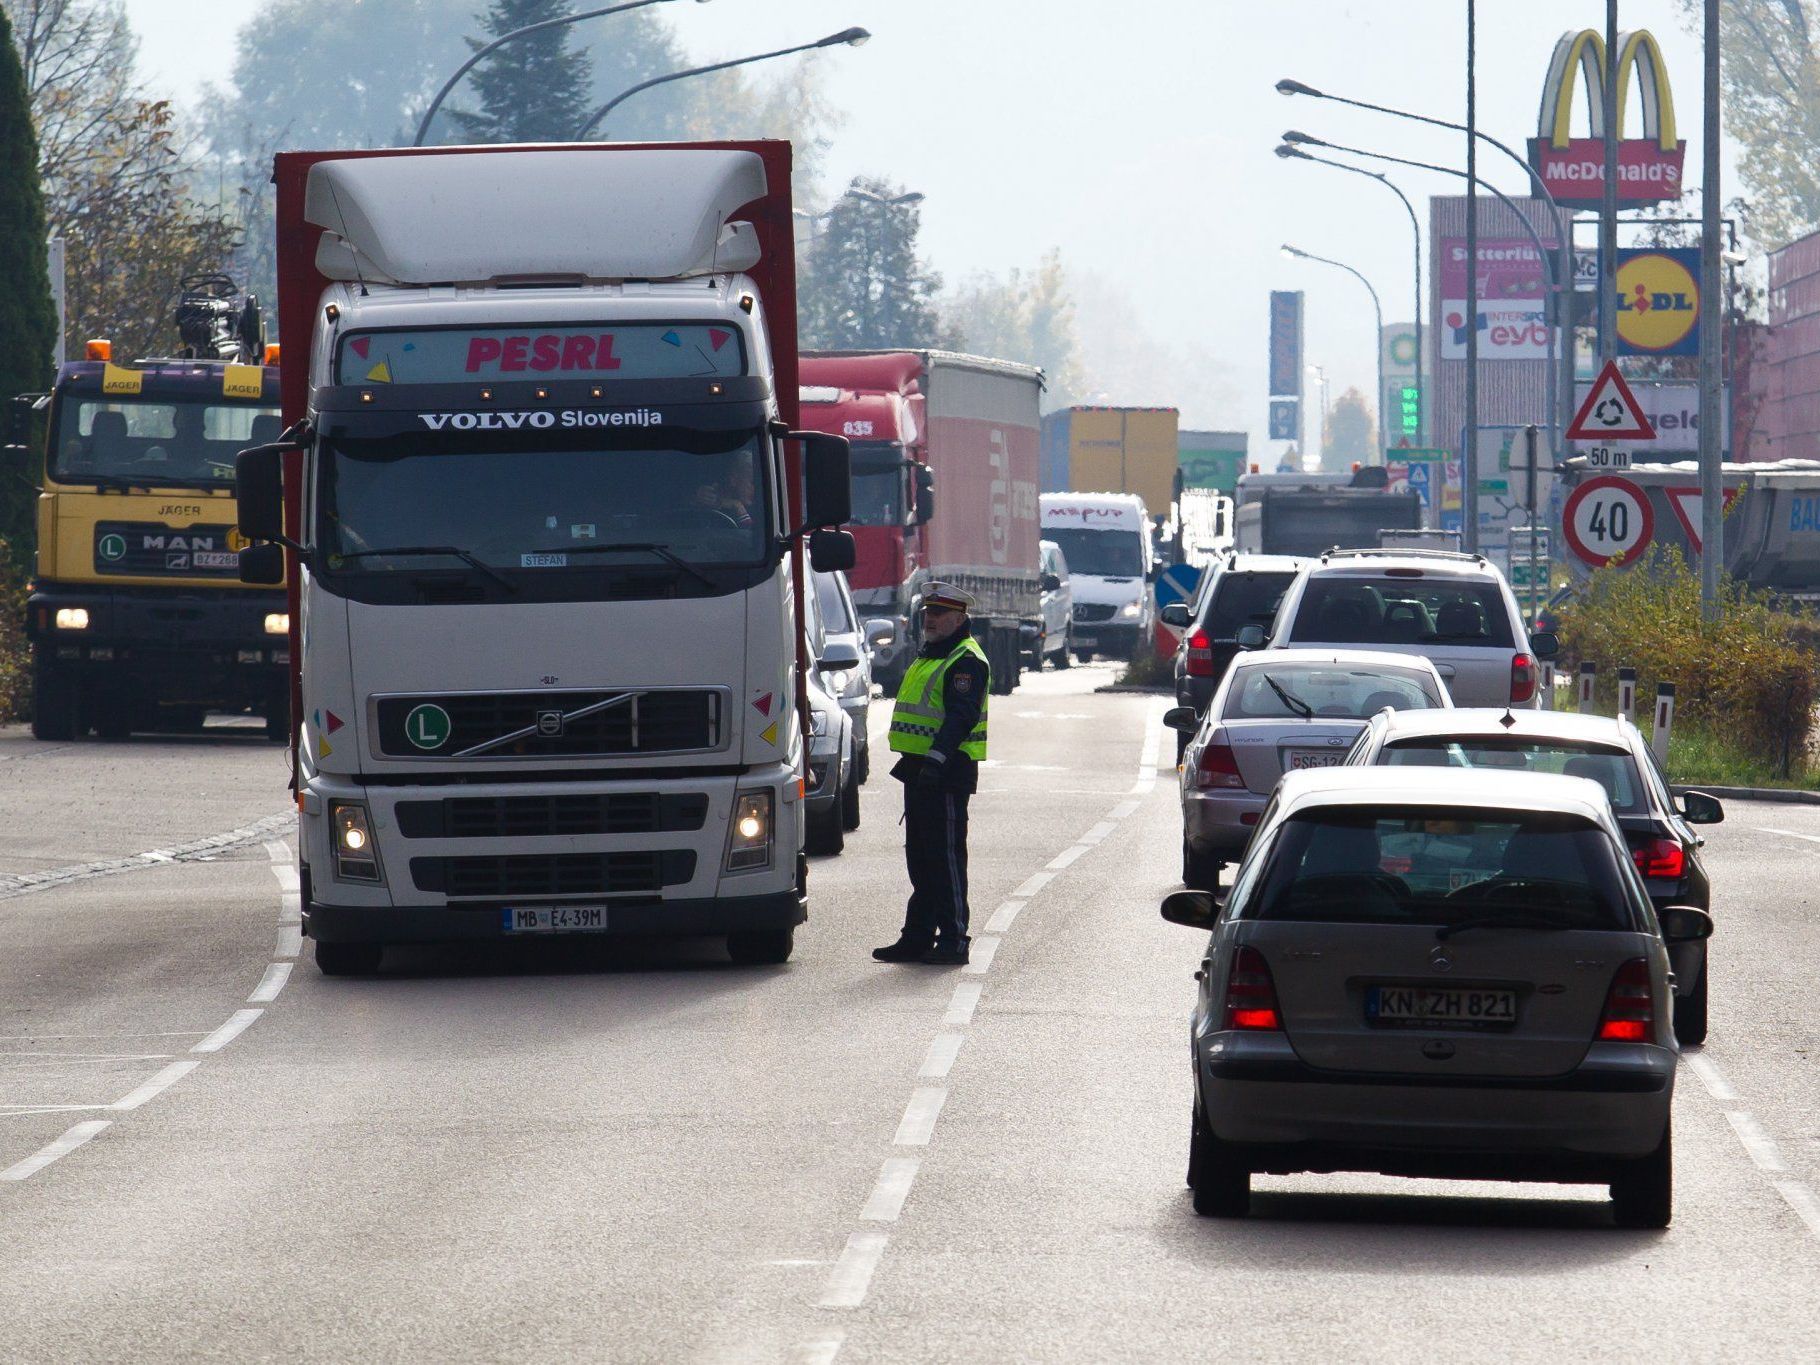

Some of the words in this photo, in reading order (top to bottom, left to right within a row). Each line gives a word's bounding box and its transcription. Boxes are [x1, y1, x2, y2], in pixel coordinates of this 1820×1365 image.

[465, 334, 621, 372] PESRL
[418, 411, 555, 430] VOLVO
[561, 408, 662, 428] Slovenija
[1591, 448, 1608, 465] 50
[1613, 452, 1627, 465] m
[1588, 501, 1628, 542] 40
[106, 539, 118, 556] L
[143, 536, 213, 550] MAN
[525, 555, 565, 566] STEFAN
[418, 713, 438, 740] L
[516, 910, 538, 928] MB
[1380, 990, 1413, 1015] KN
[1429, 992, 1461, 1016] ZH
[1468, 993, 1513, 1018] 821
